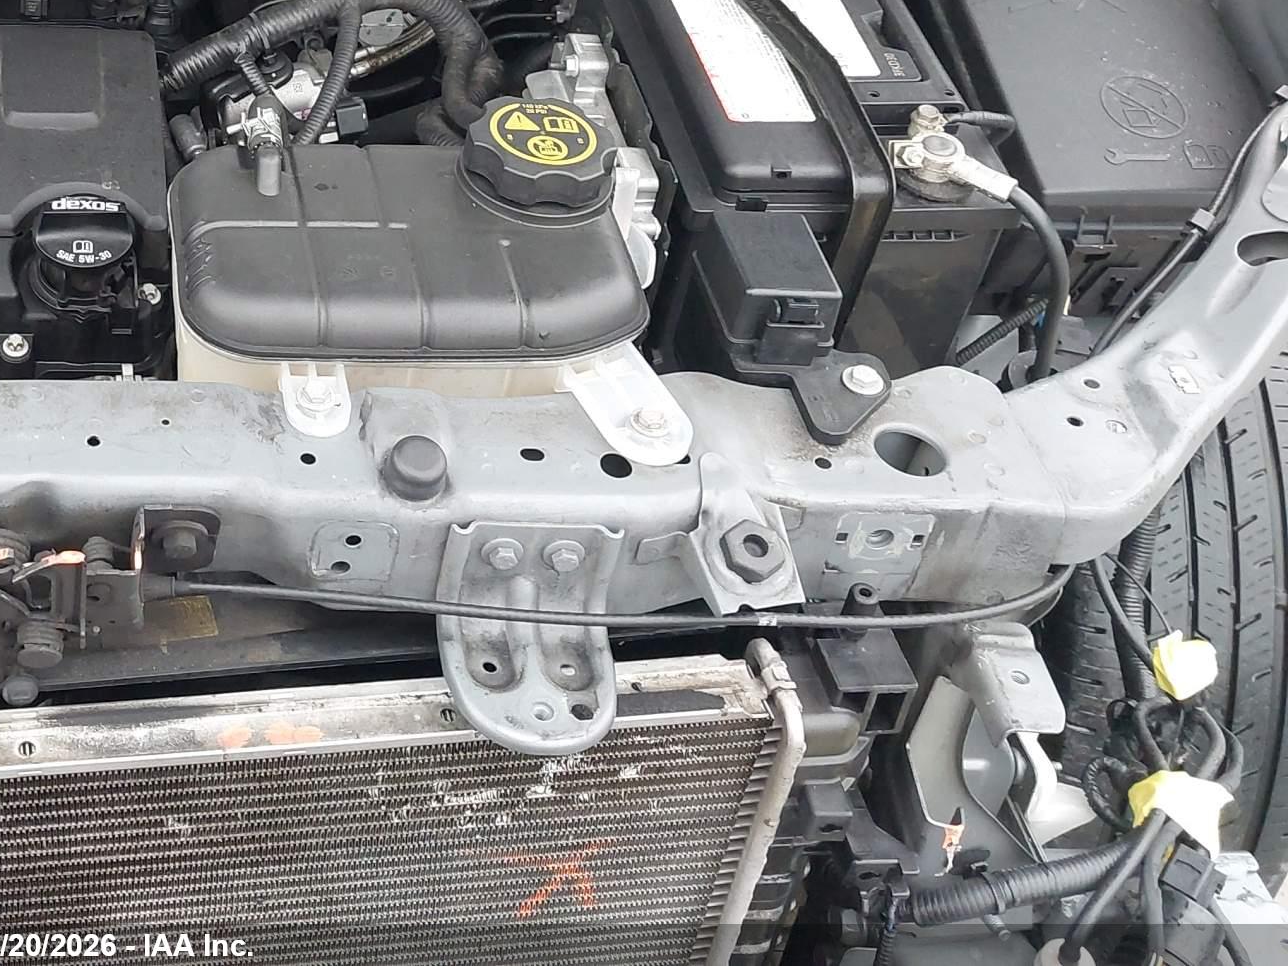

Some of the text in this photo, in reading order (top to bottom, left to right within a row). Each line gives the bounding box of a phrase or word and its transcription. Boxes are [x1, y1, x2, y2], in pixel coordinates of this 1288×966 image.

[51, 197, 121, 212] dexos
[55, 249, 113, 264] SAE 5W-30
